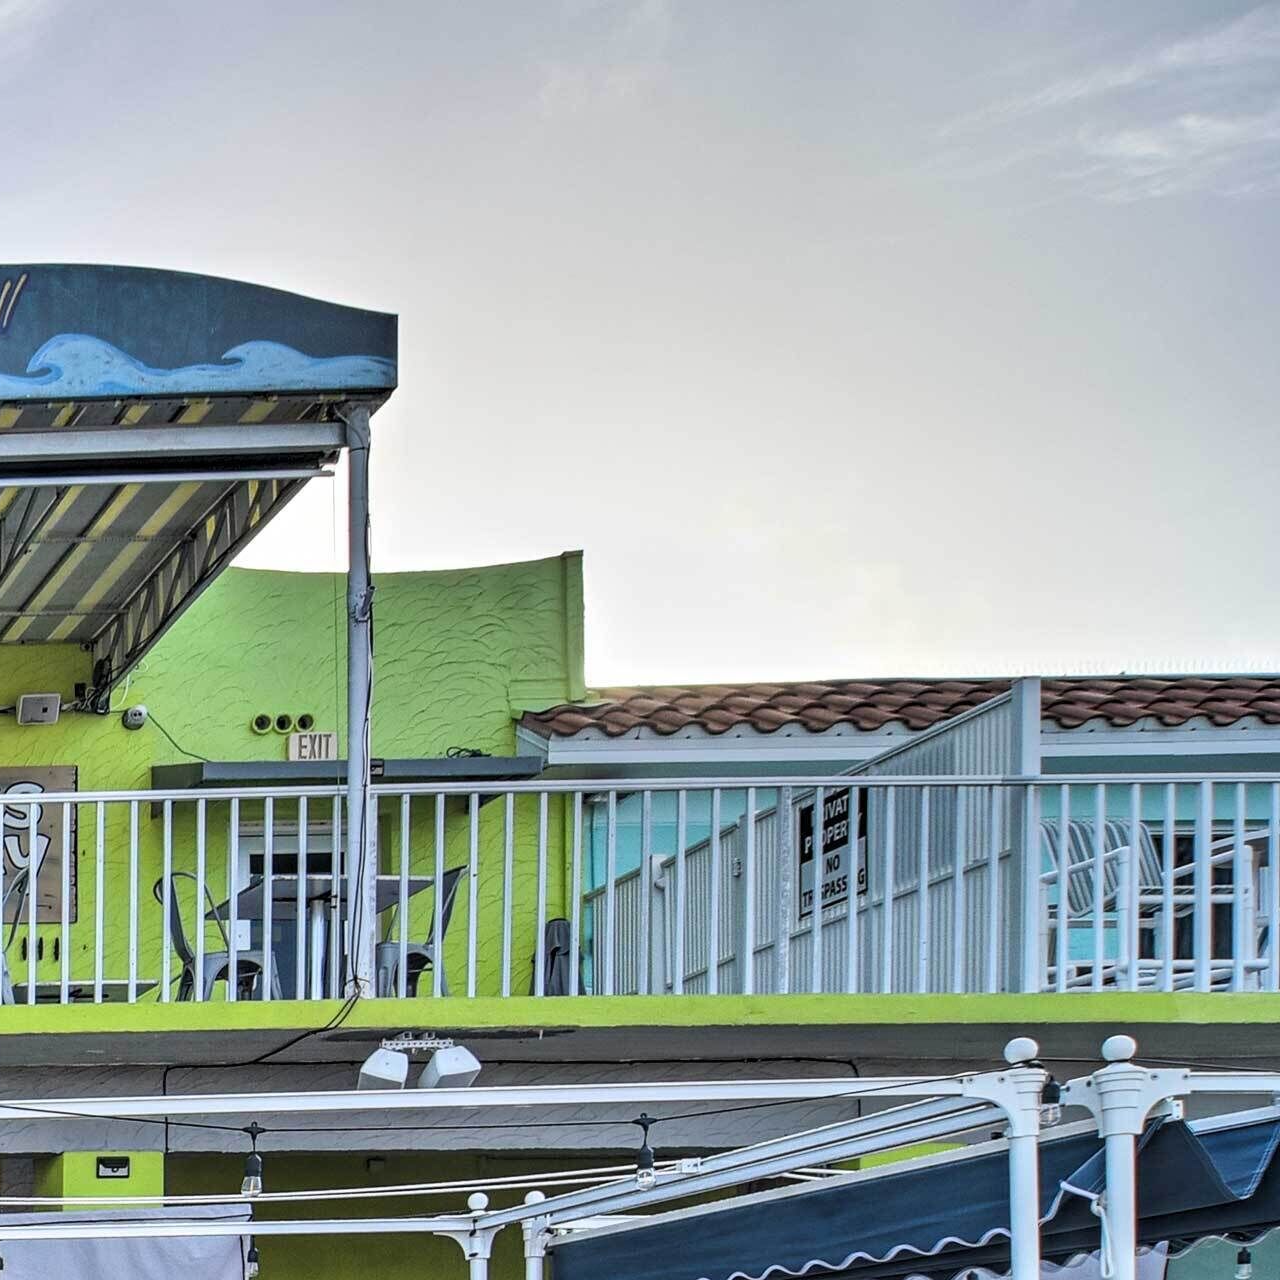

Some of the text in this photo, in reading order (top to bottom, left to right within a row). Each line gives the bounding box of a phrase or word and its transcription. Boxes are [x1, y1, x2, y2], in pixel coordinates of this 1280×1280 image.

[298, 733, 332, 760] EXIT
[803, 811, 864, 855] POPER
[825, 853, 841, 876] NO
[802, 867, 866, 908] TRPASSG
